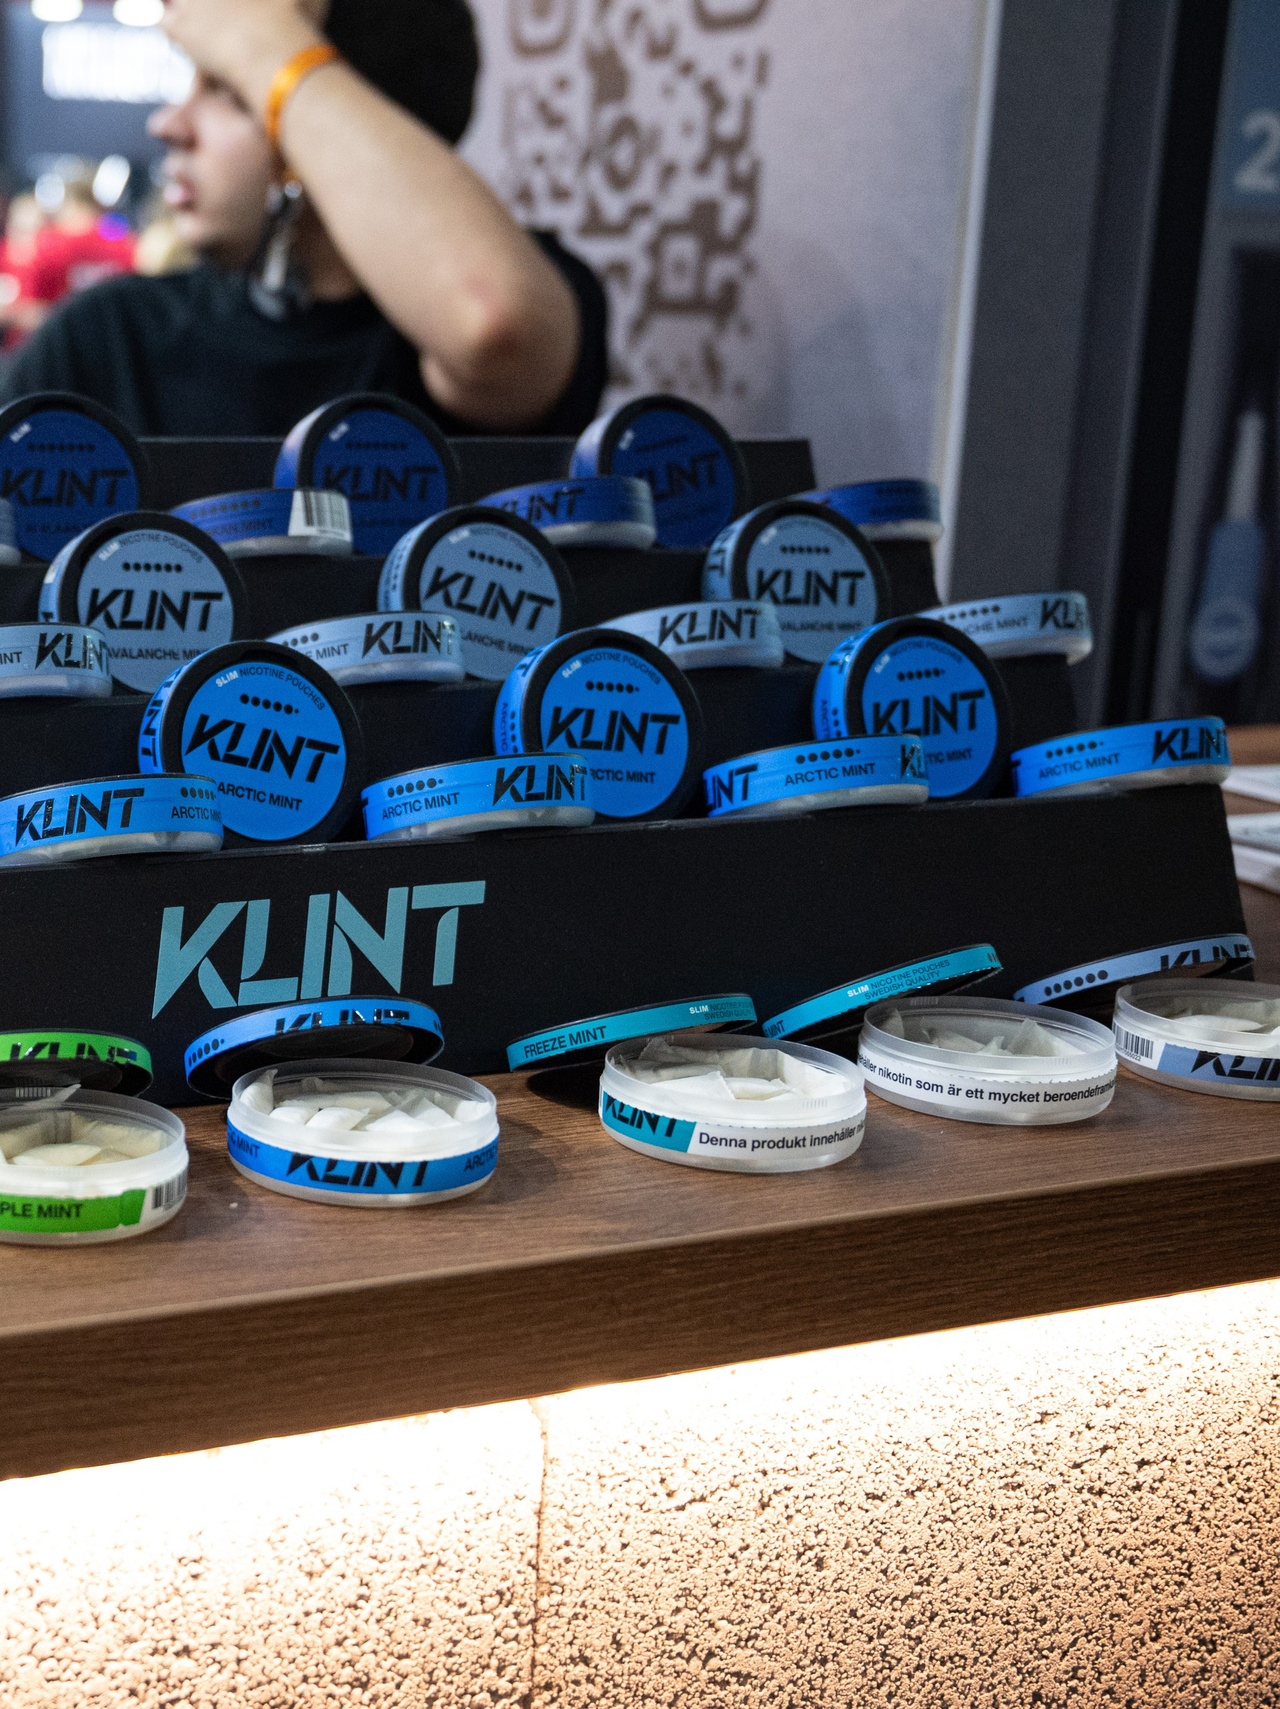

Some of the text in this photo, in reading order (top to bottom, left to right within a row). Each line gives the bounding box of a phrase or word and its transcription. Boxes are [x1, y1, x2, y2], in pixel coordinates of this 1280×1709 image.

[0, 468, 129, 507] KLINT
[323, 465, 439, 502] KLINT
[637, 450, 721, 502] LINT
[424, 566, 555, 630] KLINT
[756, 568, 865, 606] KLINT
[86, 588, 223, 631] KLINT
[658, 607, 761, 648] KLINT
[315, 643, 349, 660] MINT
[362, 619, 455, 659] KLINT
[561, 659, 582, 678] SLIM
[581, 651, 620, 665] NICOTINE
[622, 654, 662, 685] POUCHES
[215, 666, 326, 711] SLIM NICOTINE POUCHES
[546, 706, 680, 755] KLINT
[873, 689, 985, 737] KLINT
[184, 713, 340, 783] KLINT
[1038, 761, 1083, 779] ARCTIC
[1085, 752, 1120, 769] MINT
[382, 763, 587, 821] ARCTIC MINT KLINT
[589, 767, 656, 784] RCTIC MINT
[785, 763, 876, 786] ARCTIC MINT
[217, 782, 302, 811] ARCTIC MINT
[15, 788, 145, 846] KLINT
[171, 806, 210, 820] ARCTIC
[152, 880, 486, 1020] KLINT
[847, 959, 950, 998] SLIM NICOTINE POUCHES
[865, 970, 941, 1000] SWEDISH QUALITY
[689, 1005, 709, 1014] SLIM
[704, 1010, 732, 1020] SWEDISH
[524, 1025, 606, 1059] FREEZE MINT
[878, 1065, 912, 1087] nikotin
[916, 1079, 943, 1094] som
[947, 1083, 962, 1097] är
[965, 1087, 985, 1100] ett
[988, 1091, 1040, 1105] mycket
[699, 1132, 747, 1148] Denna
[751, 1135, 807, 1152] produkt
[810, 1125, 856, 1147] innehåller
[36, 1203, 84, 1219] MINT
